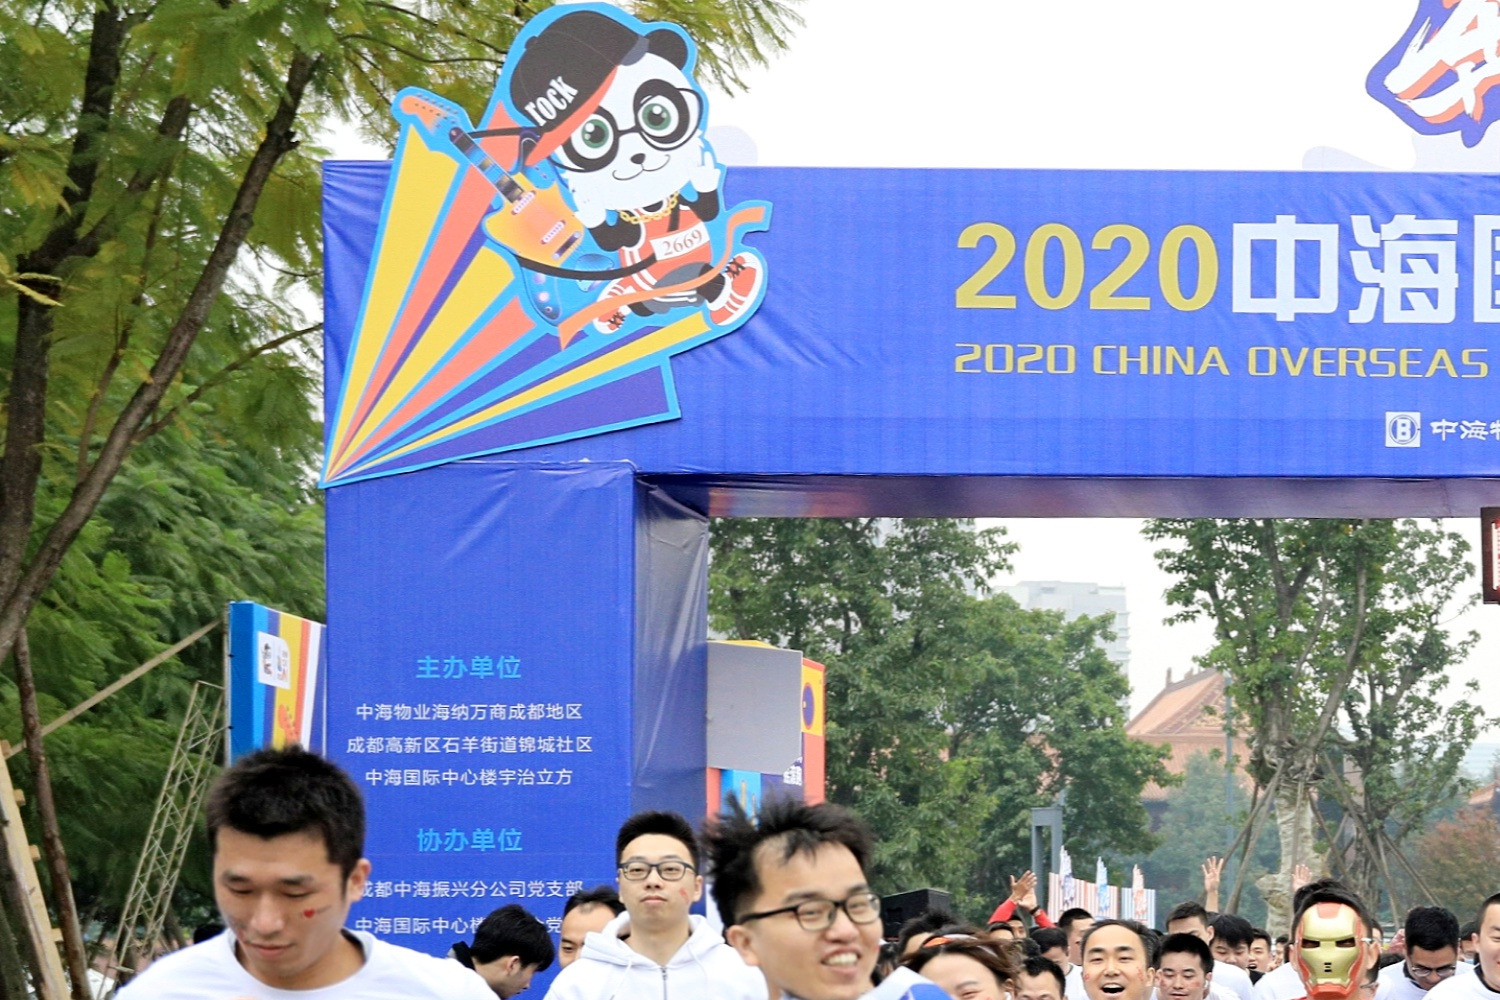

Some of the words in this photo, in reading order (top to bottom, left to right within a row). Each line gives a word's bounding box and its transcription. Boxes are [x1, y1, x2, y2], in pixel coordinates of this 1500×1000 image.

[524, 75, 579, 127] rock
[663, 227, 704, 257] 2669
[954, 343, 1076, 375] 2020
[1092, 344, 1231, 376] CHINA
[1247, 346, 1490, 379] OVERSEAS
[416, 656, 522, 680] 主办单位
[355, 702, 583, 722] 中海物业海纳万商成都地区
[346, 735, 593, 755] 成都高新区石羊街道锦城社区
[365, 768, 574, 787] 中海国际中心楼宇治立方
[416, 828, 523, 852] 协办单位
[362, 880, 583, 898] 成都中海振兴分公司党支部
